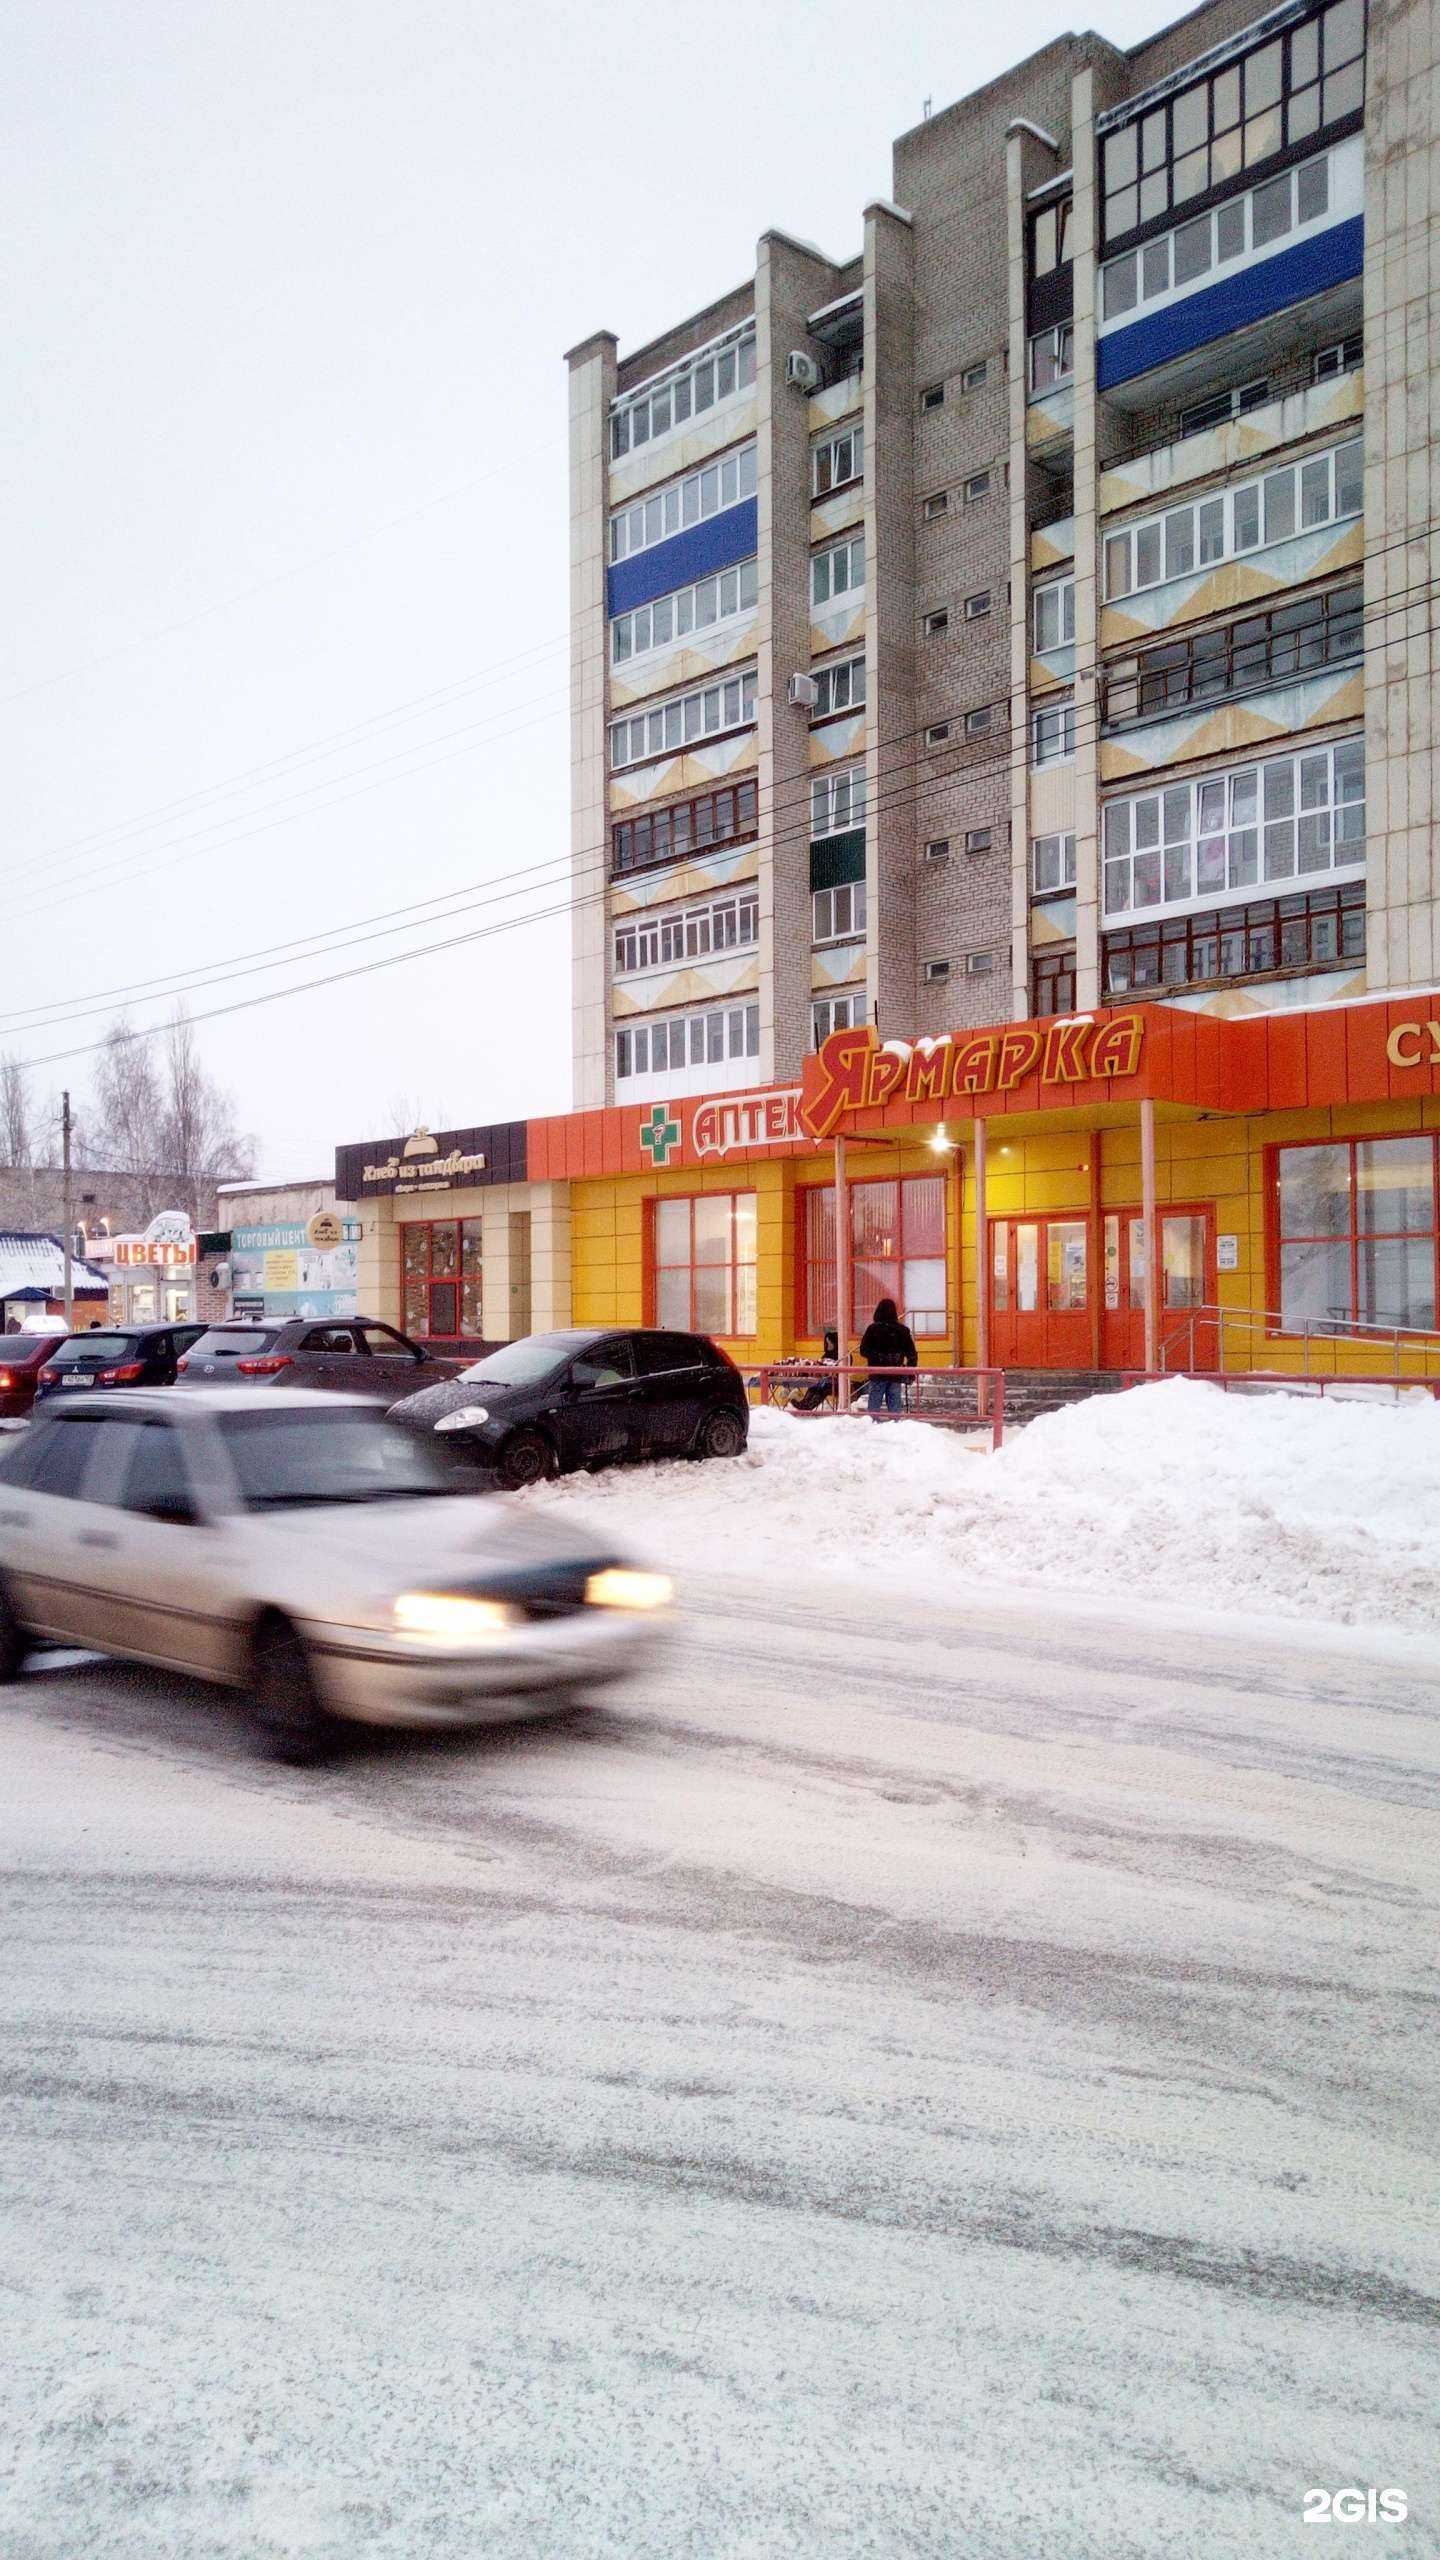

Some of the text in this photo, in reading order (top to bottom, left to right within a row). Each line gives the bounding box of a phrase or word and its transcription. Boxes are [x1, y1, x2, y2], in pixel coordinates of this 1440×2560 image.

[801, 1014, 1145, 1137] ЯРМАРКА
[693, 1090, 803, 1155] АПТЕК
[362, 1156, 400, 1182] Хлеб
[399, 1164, 417, 1179] из
[237, 1229, 306, 1249] ТОРГОВЫЙ ЦЕНТ
[116, 1243, 196, 1265] ЦВЕТЫ
